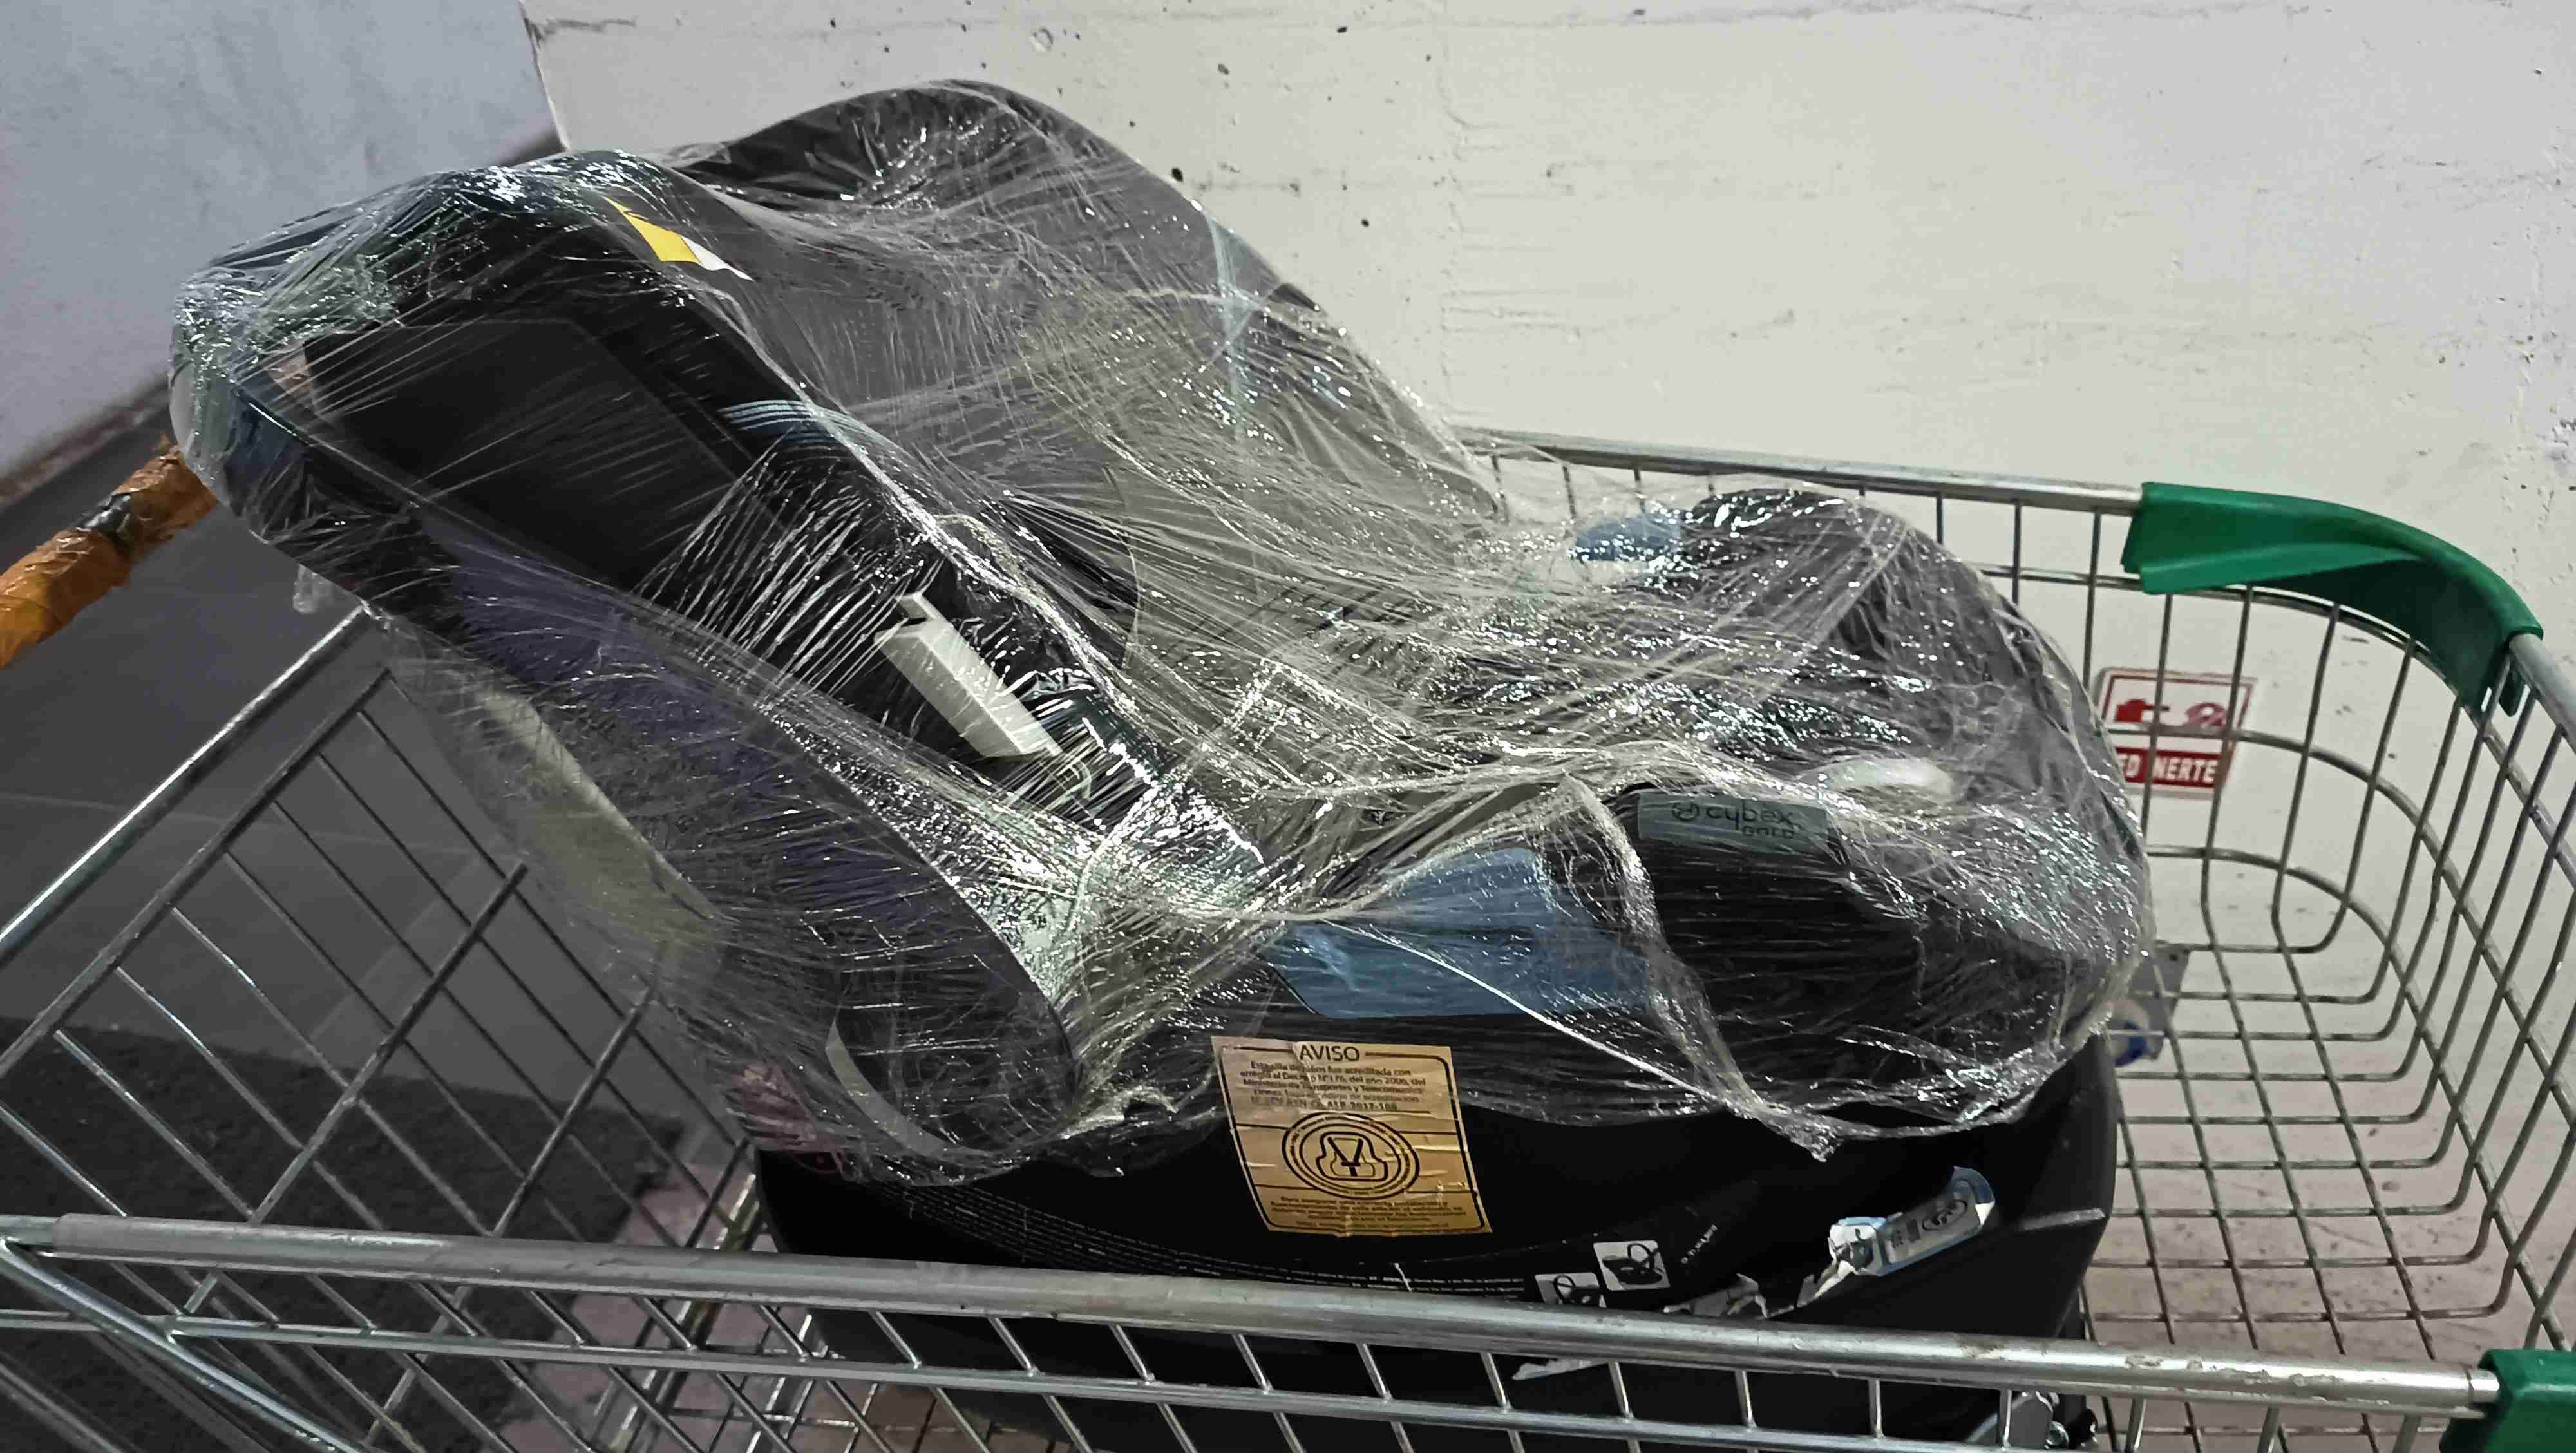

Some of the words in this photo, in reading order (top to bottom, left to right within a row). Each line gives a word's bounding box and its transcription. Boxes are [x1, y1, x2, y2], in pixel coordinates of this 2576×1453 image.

[2150, 756, 2219, 783] NERTE
[1705, 800, 1795, 830] cybex
[1300, 1045, 1360, 1062] AVISO
